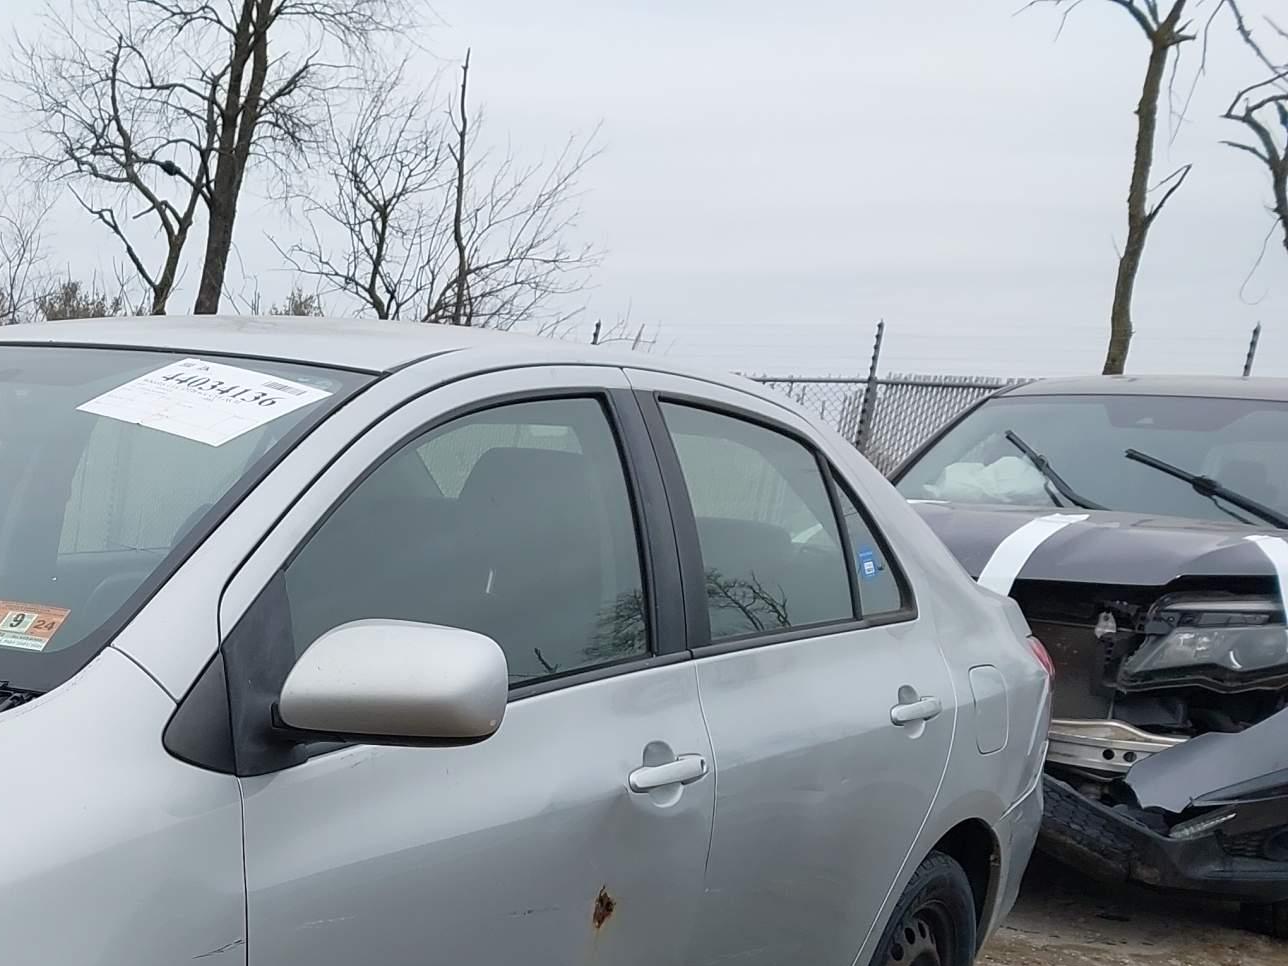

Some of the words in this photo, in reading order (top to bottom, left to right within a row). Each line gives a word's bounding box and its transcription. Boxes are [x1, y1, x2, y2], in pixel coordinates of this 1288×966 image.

[162, 372, 283, 406] 44034136
[9, 613, 26, 628] 9
[33, 619, 56, 631] 24
